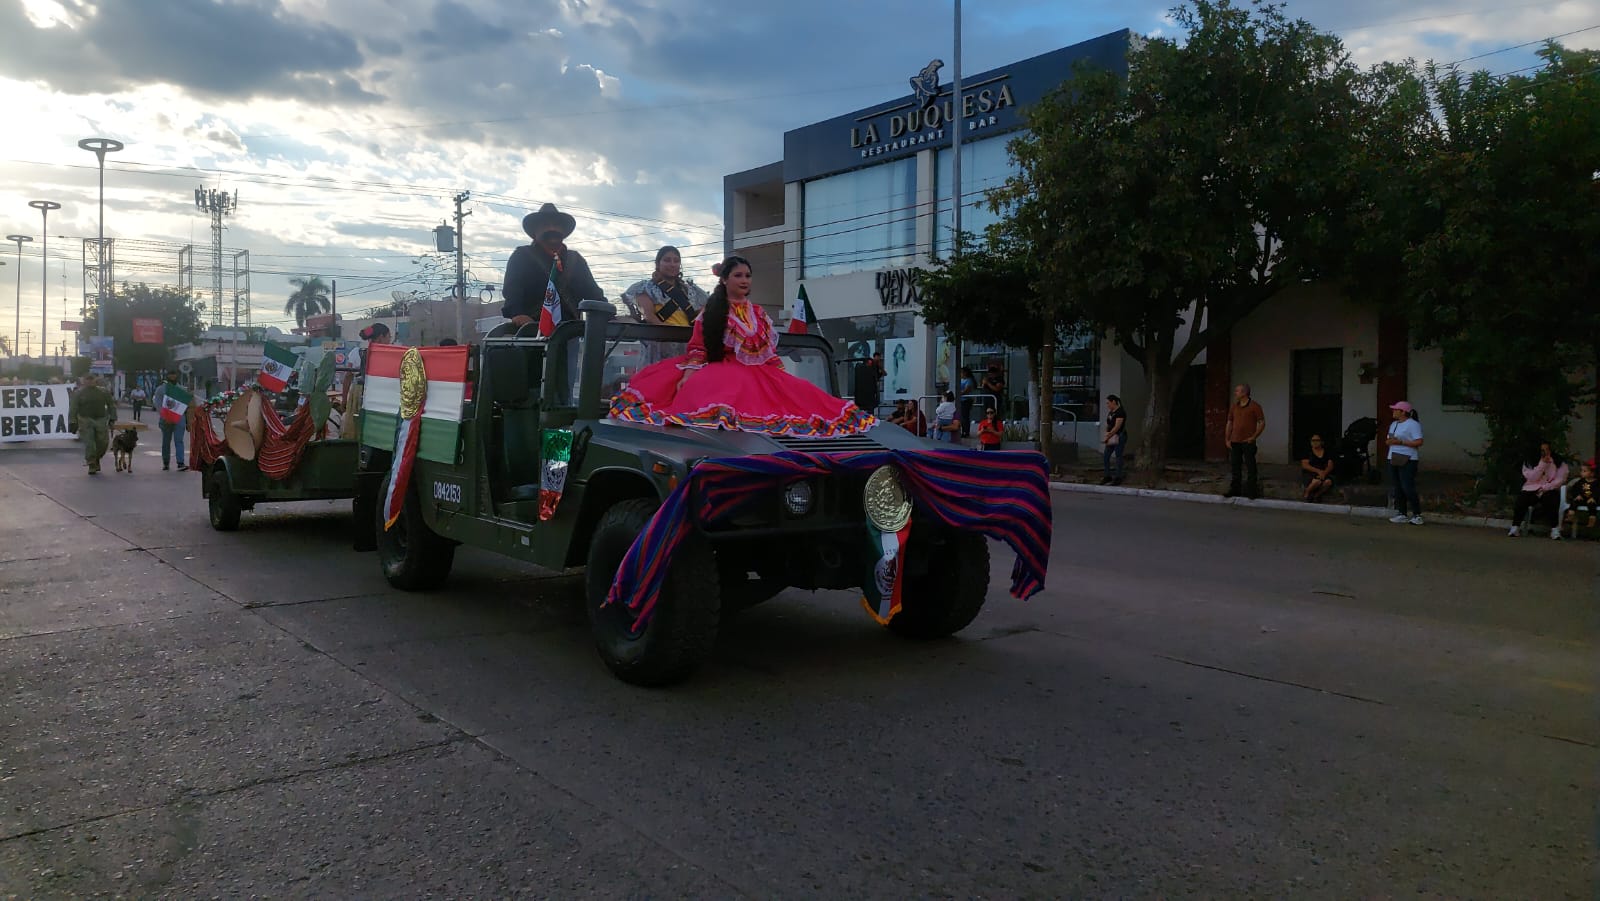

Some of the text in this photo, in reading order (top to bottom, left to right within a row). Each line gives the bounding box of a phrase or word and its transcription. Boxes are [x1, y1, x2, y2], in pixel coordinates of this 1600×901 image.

[850, 84, 1016, 149] LA DUQUESA
[861, 115, 998, 158] RESTAURANT BAR
[875, 267, 920, 290] DIAN
[2, 388, 55, 408] ERRA
[1, 414, 76, 436] BERTA
